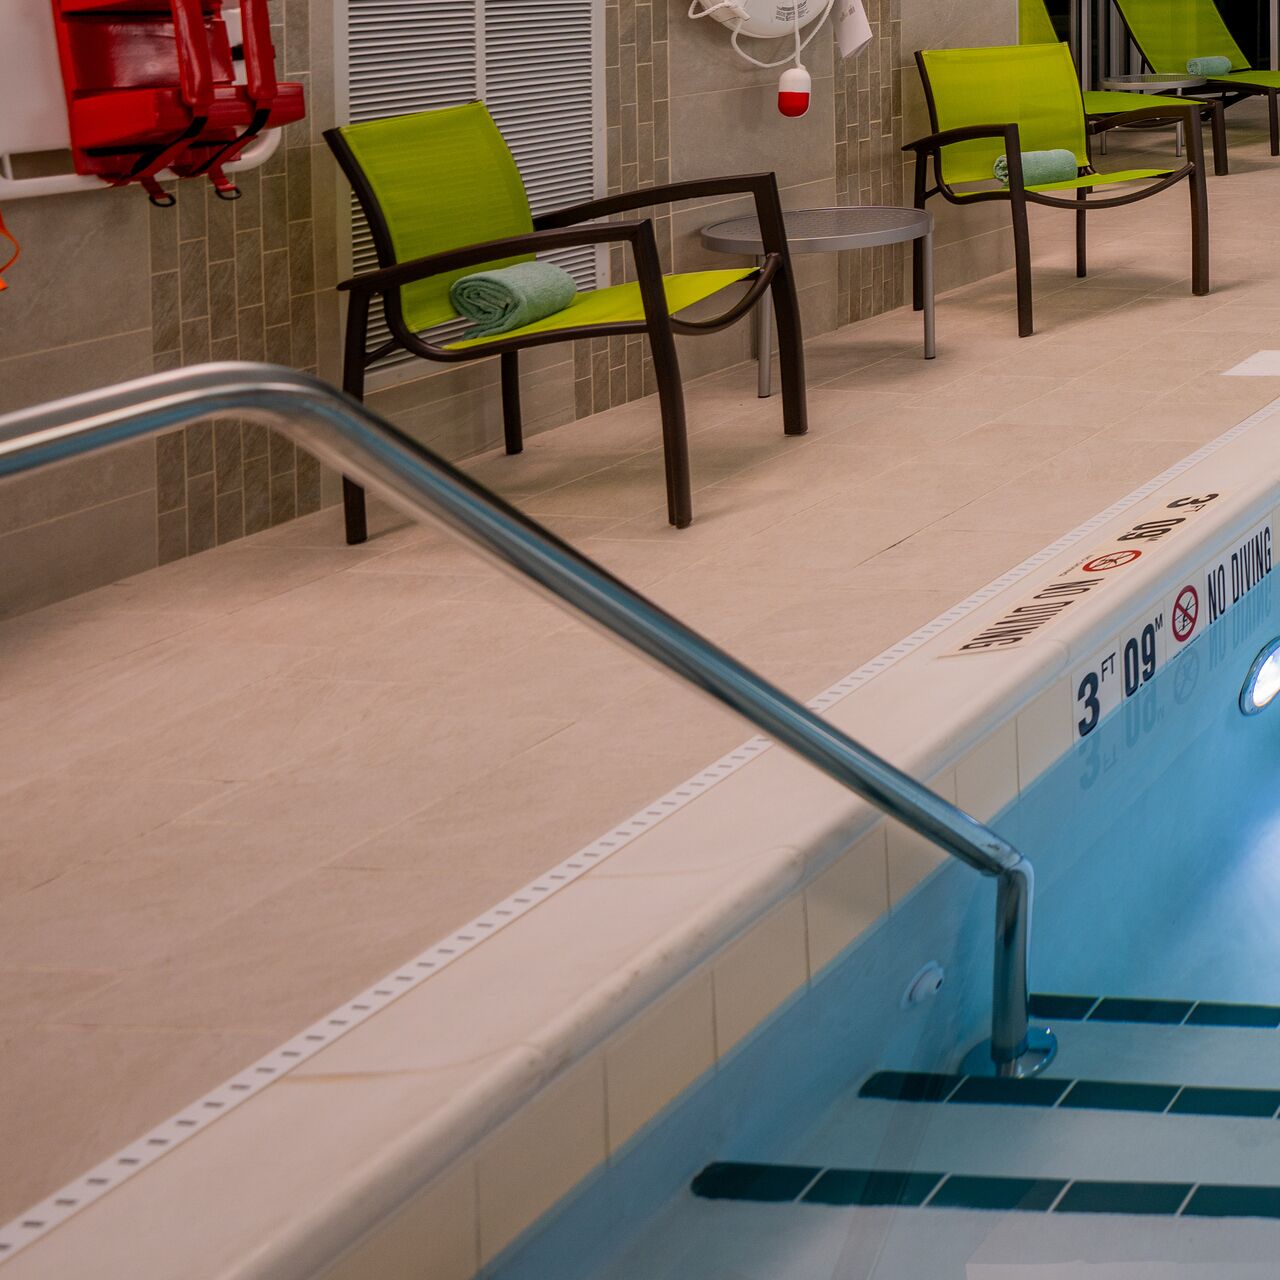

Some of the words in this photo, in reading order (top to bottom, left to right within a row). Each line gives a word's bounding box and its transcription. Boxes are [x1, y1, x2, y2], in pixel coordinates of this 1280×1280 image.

[1166, 493, 1219, 509] 3
[1183, 504, 1206, 513] FT
[1033, 577, 1105, 600] NO
[1207, 563, 1226, 625] NO
[1231, 526, 1272, 605] DIVING
[958, 599, 1076, 651] DIVING
[1077, 671, 1101, 738] 3
[1101, 652, 1116, 683] FT
[1154, 613, 1164, 633] M
